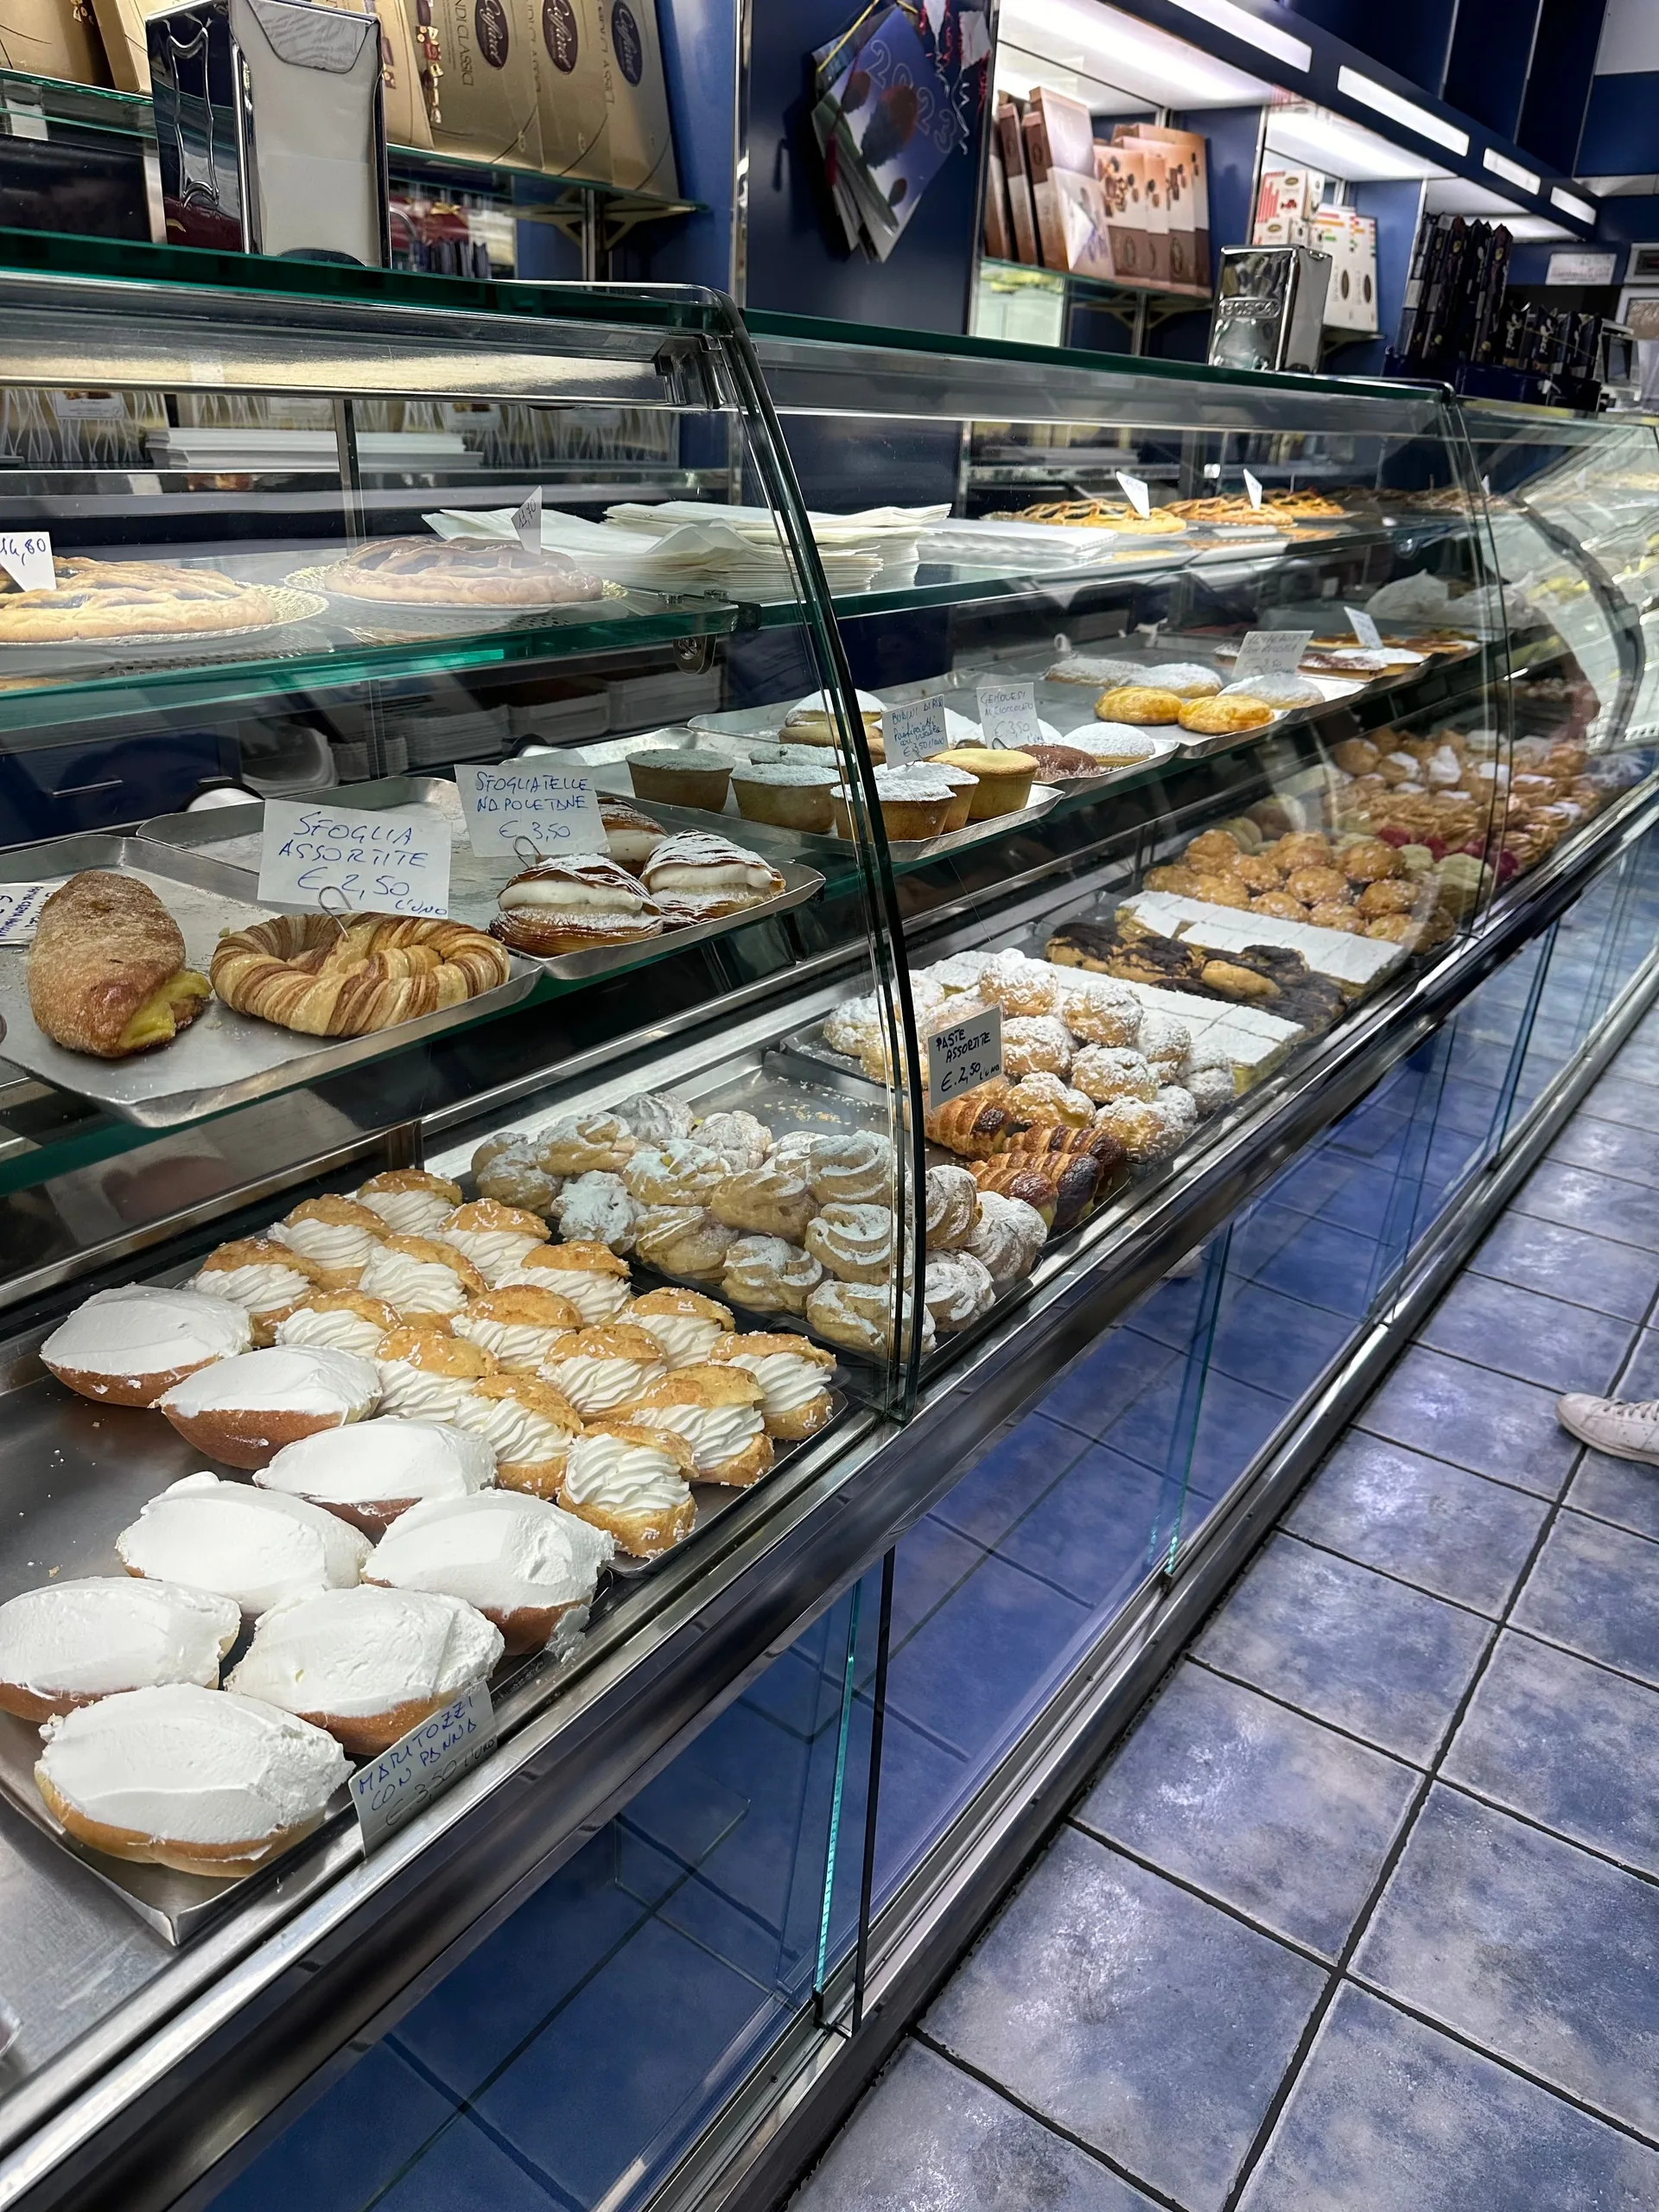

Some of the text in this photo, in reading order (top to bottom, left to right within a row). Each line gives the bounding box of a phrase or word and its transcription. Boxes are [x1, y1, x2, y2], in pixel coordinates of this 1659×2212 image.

[479, 0, 504, 65] Caffarel
[547, 0, 572, 69] Caffarel
[457, 24, 474, 86] CLASSICI
[981, 690, 1026, 706] GENOVESI
[892, 707, 918, 725] BUDINI
[995, 721, 1005, 737] €
[903, 747, 912, 757] €
[476, 772, 593, 793] SFOGLIATELLE
[294, 811, 412, 844] SFOGLIA
[499, 821, 570, 842] € 3,50
[278, 839, 429, 868] ASSORTITE
[297, 867, 328, 890] €
[341, 874, 410, 900] 2,50
[936, 1028, 966, 1052] PASTE
[945, 1032, 991, 1064] ASSORTITE
[359, 1696, 474, 1796] MARITOZZI
[371, 1718, 477, 1811] CON PANNA
